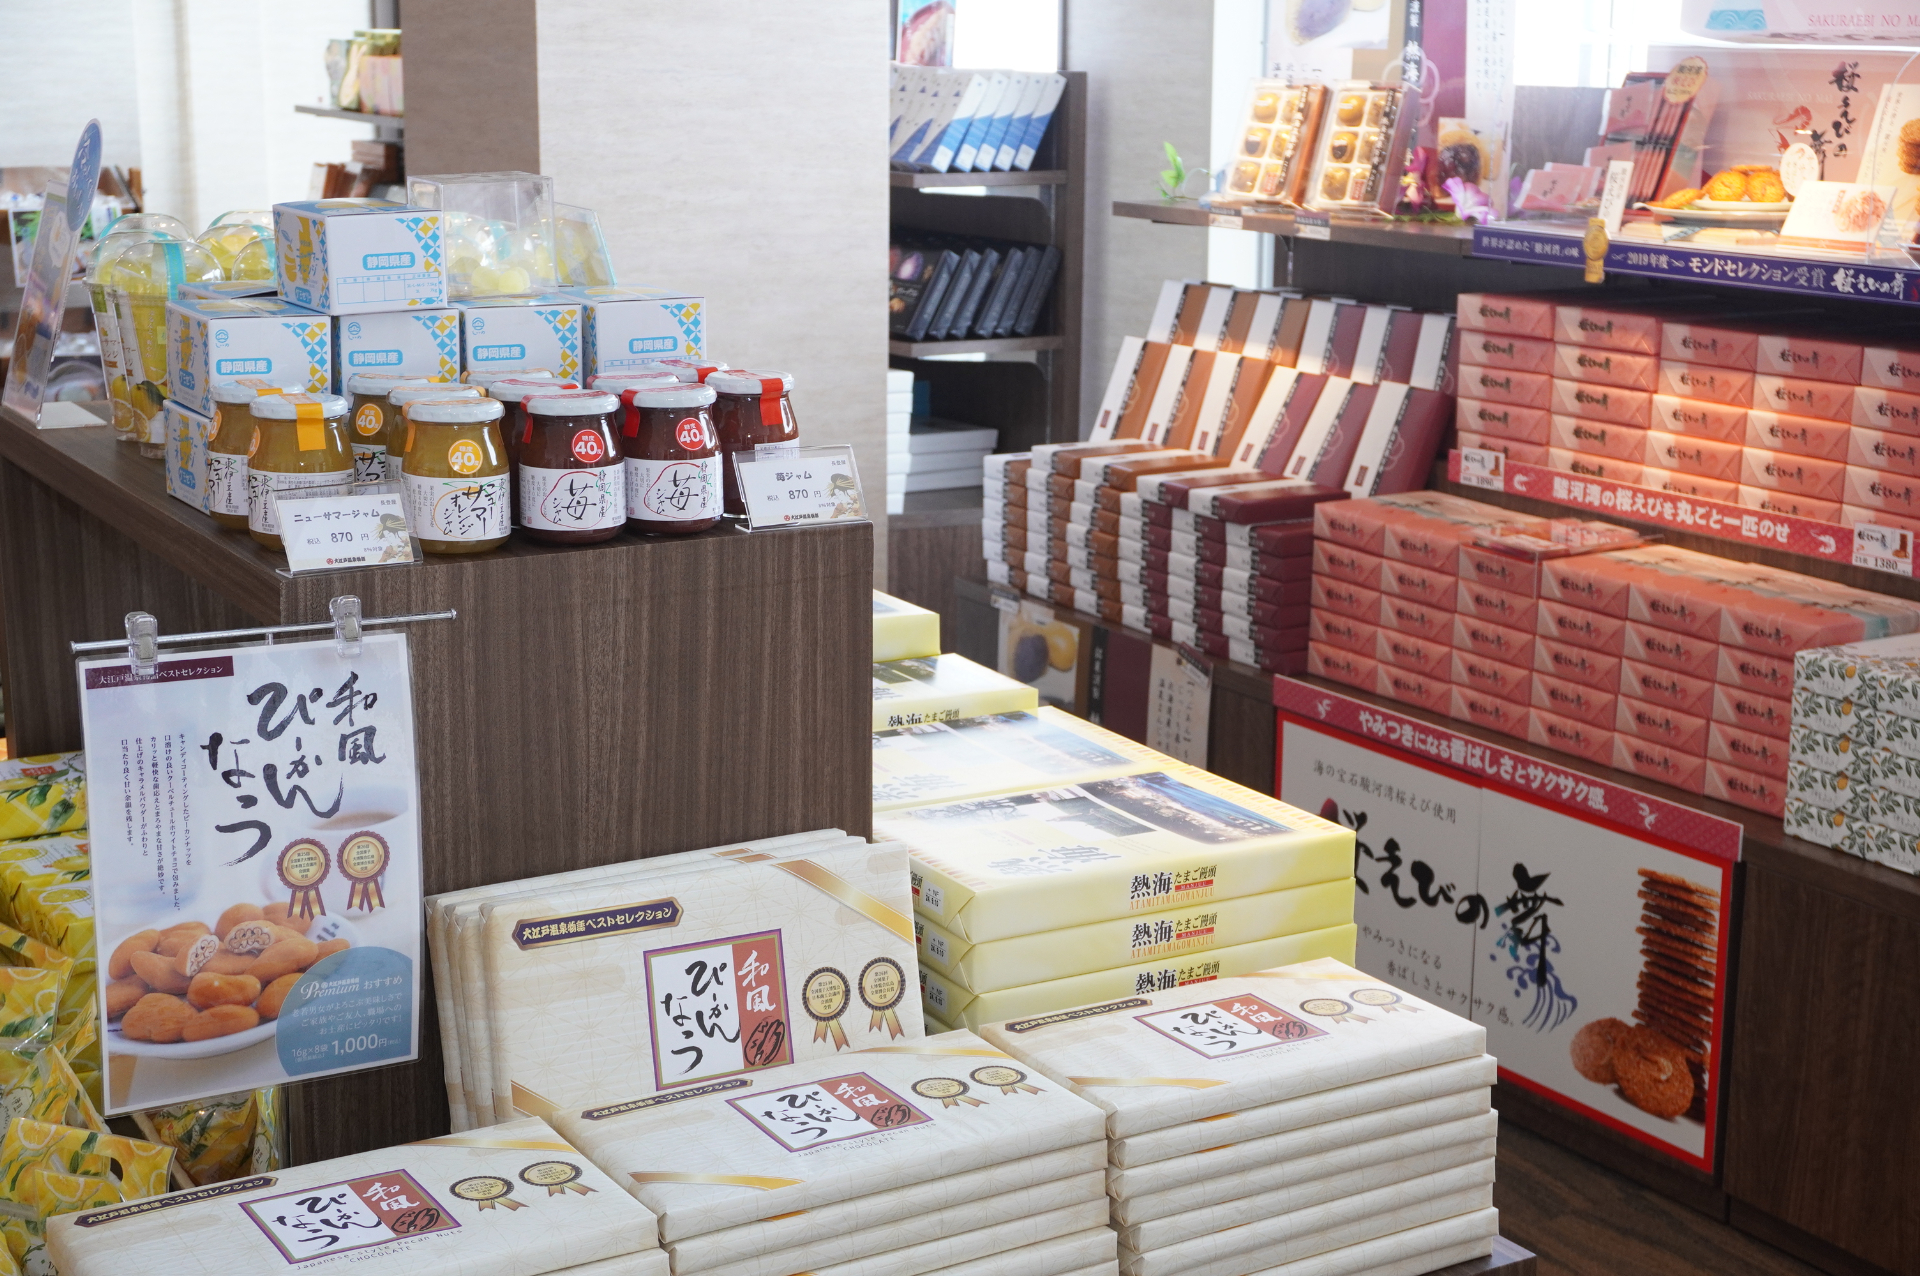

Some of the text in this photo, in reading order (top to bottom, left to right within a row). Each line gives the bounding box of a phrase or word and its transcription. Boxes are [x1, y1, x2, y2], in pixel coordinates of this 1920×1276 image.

[1808, 14, 1901, 27] SAKURAEBI NO
[1829, 61, 1861, 158] 桜えびの
[367, 254, 412, 269] 静岡県産
[1689, 256, 1827, 289] モンドセレクション受賞
[352, 351, 399, 365] 静岡県産
[477, 346, 522, 359] 静岡県産
[632, 338, 675, 351] 静岡県産
[220, 360, 268, 373] 静岡県産
[767, 488, 822, 502] 税込 870 円
[1552, 474, 1791, 543] 駿河湾の桜えびを丸ごと一匹のせ
[294, 508, 380, 523] ニューサマージャム
[306, 531, 370, 545] 税込 870 円
[326, 671, 387, 765] 和風
[247, 681, 344, 819] ぴーかん
[1358, 709, 1610, 814] やみつきになる香ばしさとサクサク感。
[200, 731, 273, 868] なっつ
[1313, 758, 1457, 825] 海の宝石駿河湾桜えび使用
[1130, 864, 1218, 900] 熱海 たまご饅頭
[1180, 880, 1207, 890] MANJUU
[1129, 887, 1215, 911] ATAMITAMAGOMANJUU
[522, 906, 673, 941] 大江戸温泉物語ベストセレクション
[1131, 911, 1218, 949] 熱海 たまご饅頭
[1181, 928, 1208, 938] MANJUU
[1130, 935, 1216, 959] ATAMITAMAGOMANJUU
[1362, 925, 1442, 970] やみつきになる
[300, 975, 403, 1000] Premium おすすめ
[737, 949, 777, 1013] 和風
[1135, 960, 1220, 996] 熱海 たまご饅頭
[1386, 960, 1514, 1027] 香ばしさとサクサク感。
[292, 992, 402, 1018] 老若男女がよろこぶ美味しさで
[685, 960, 741, 1043] ぴーかん
[1230, 1002, 1283, 1023] 和風
[660, 992, 704, 1076] なっつ
[1171, 1026, 1237, 1051] なっつ
[834, 1082, 889, 1108] 和風
[761, 1109, 828, 1142] なっつ
[362, 1182, 420, 1211] 和風
[271, 1214, 340, 1250] なっつ
[296, 1228, 463, 1271] Japanese-style Pecan Nuts
[349, 1245, 412, 1264] CHOCOLATE
